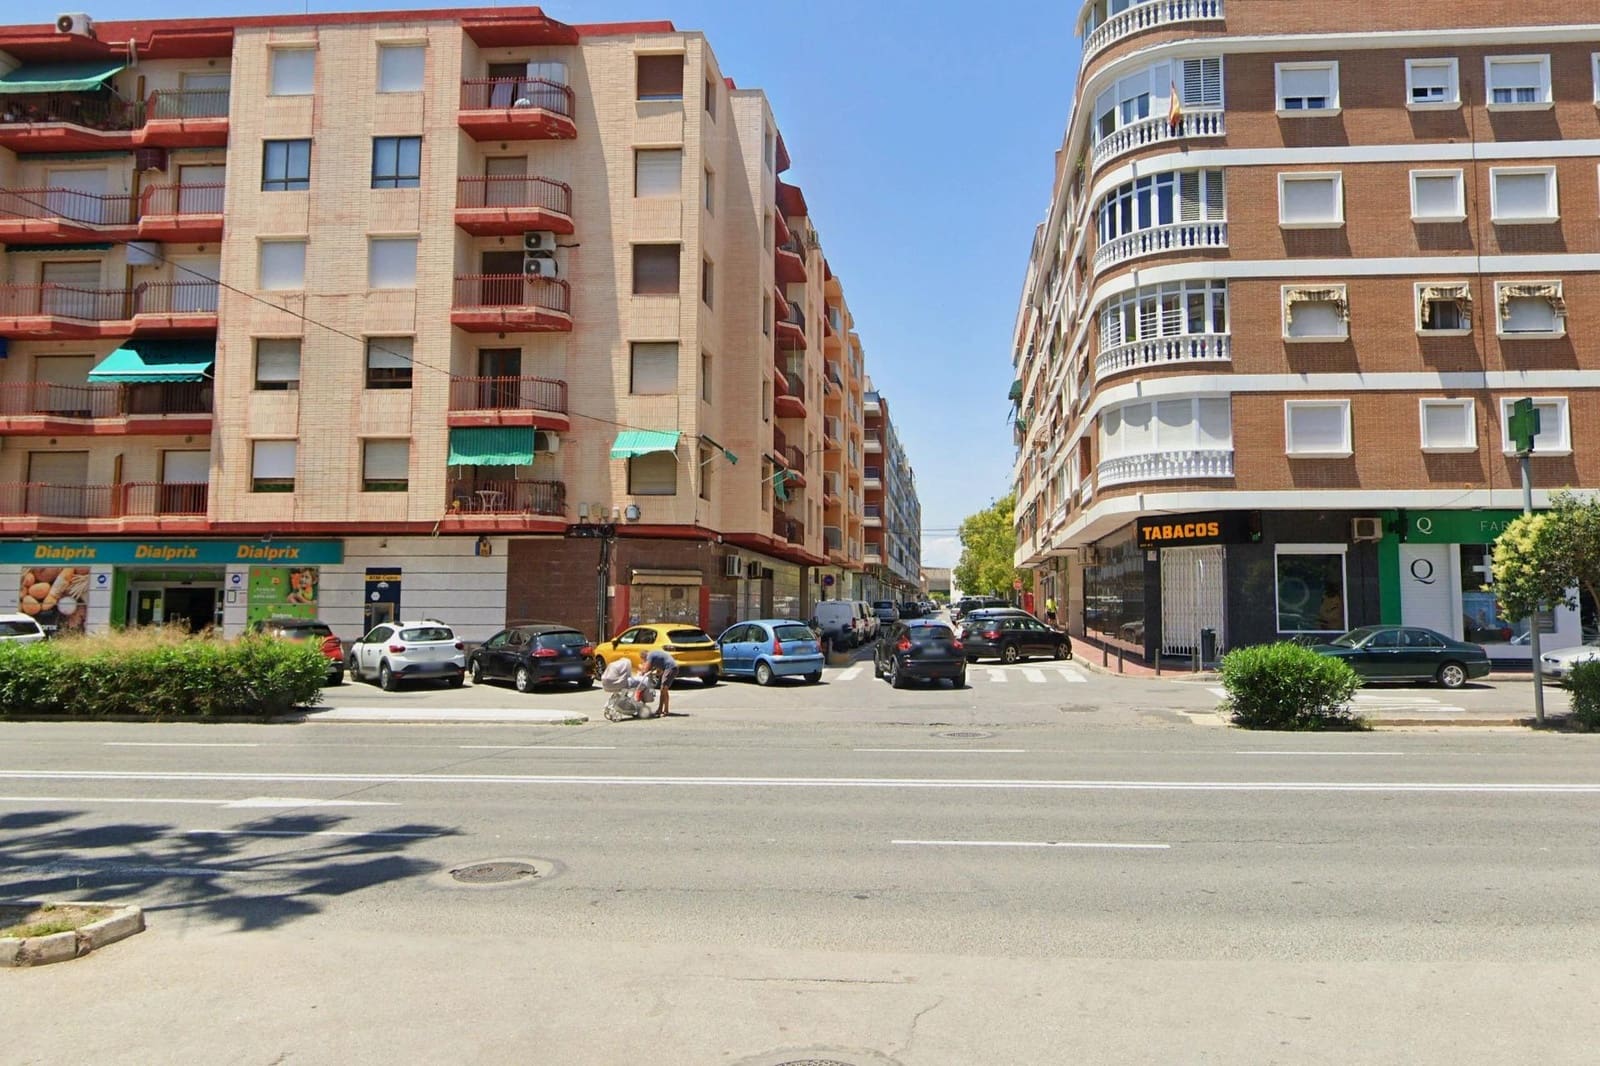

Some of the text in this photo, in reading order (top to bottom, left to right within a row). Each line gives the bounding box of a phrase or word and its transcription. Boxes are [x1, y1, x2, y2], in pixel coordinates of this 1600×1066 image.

[1142, 521, 1219, 541] TABACOS
[1416, 516, 1433, 535] Q
[34, 544, 97, 561] Dialprix
[134, 544, 198, 561] Dialprix
[236, 544, 300, 561] Dialprix
[1410, 558, 1437, 585] Q
